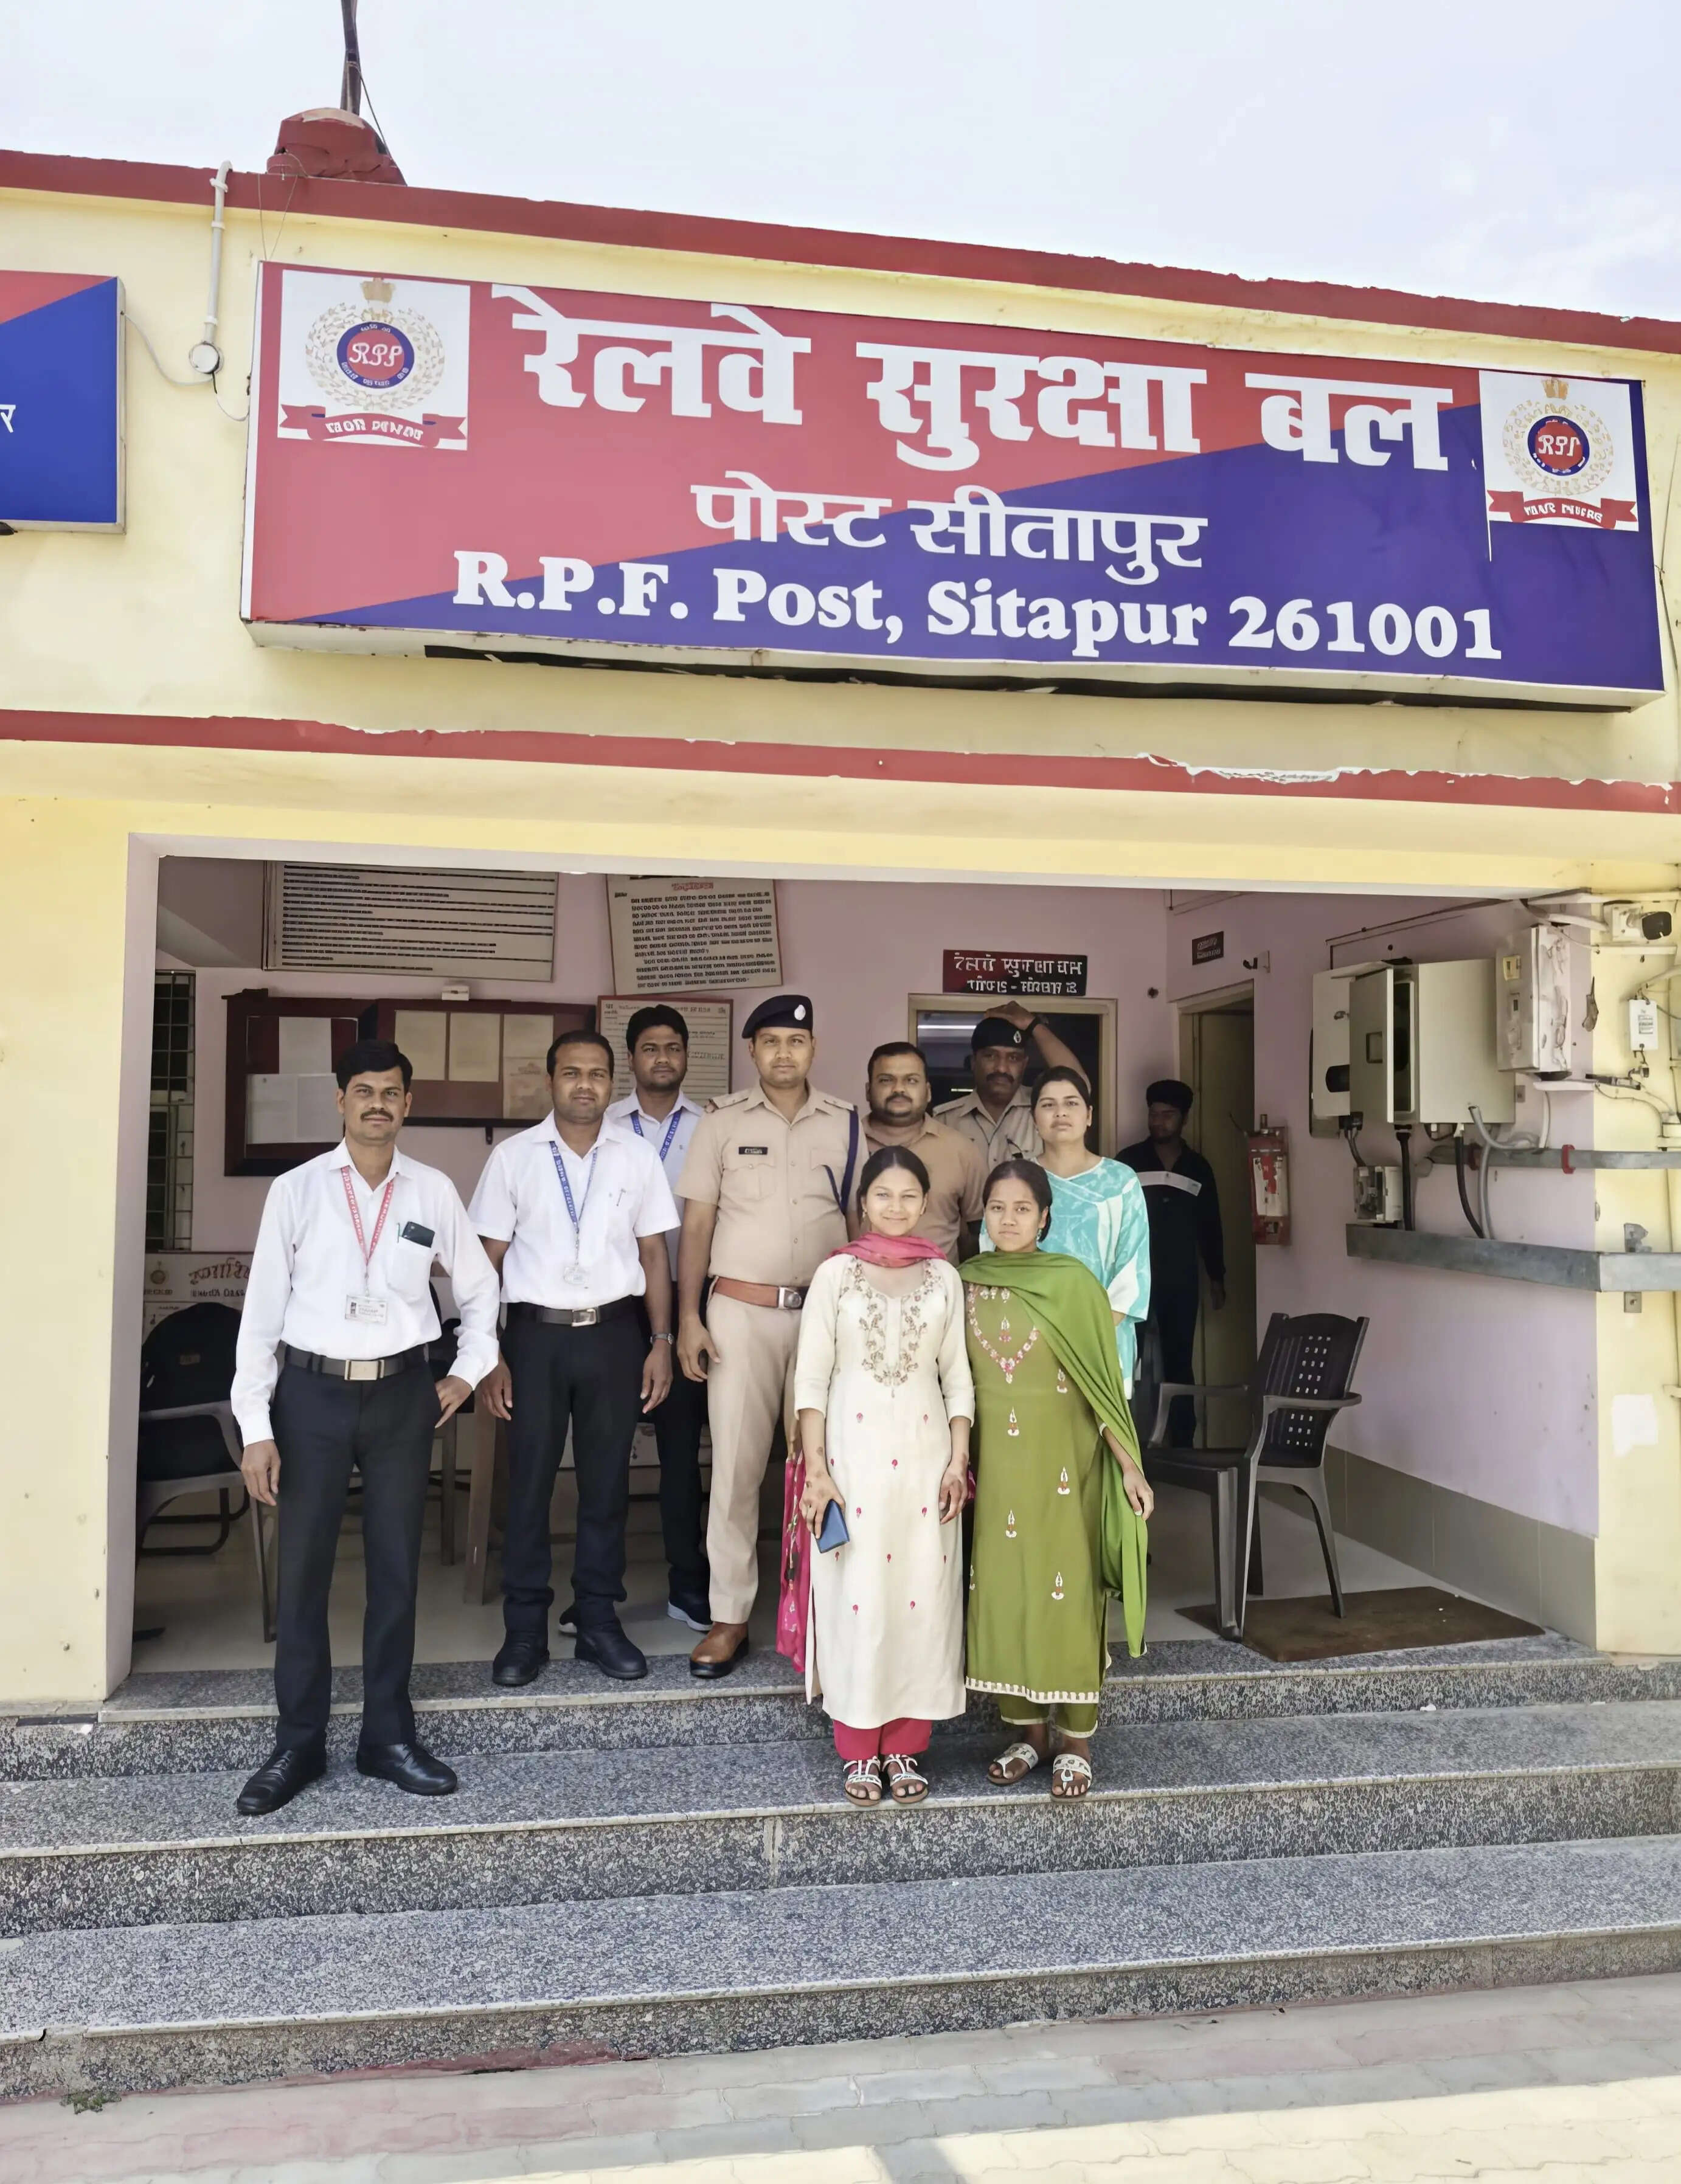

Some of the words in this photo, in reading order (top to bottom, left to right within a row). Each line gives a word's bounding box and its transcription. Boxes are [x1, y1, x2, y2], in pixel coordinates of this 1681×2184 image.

[491, 283, 811, 426] रेलवे
[856, 342, 1207, 472] सुरक्षा
[1244, 372, 1454, 471] बल
[690, 470, 893, 548] पोस्ट
[907, 484, 1208, 586] सीतापुर
[452, 550, 688, 620] R.P.F.
[713, 568, 903, 644] Post,
[927, 578, 1207, 658] Sitapur
[1229, 596, 1502, 660] 261001
